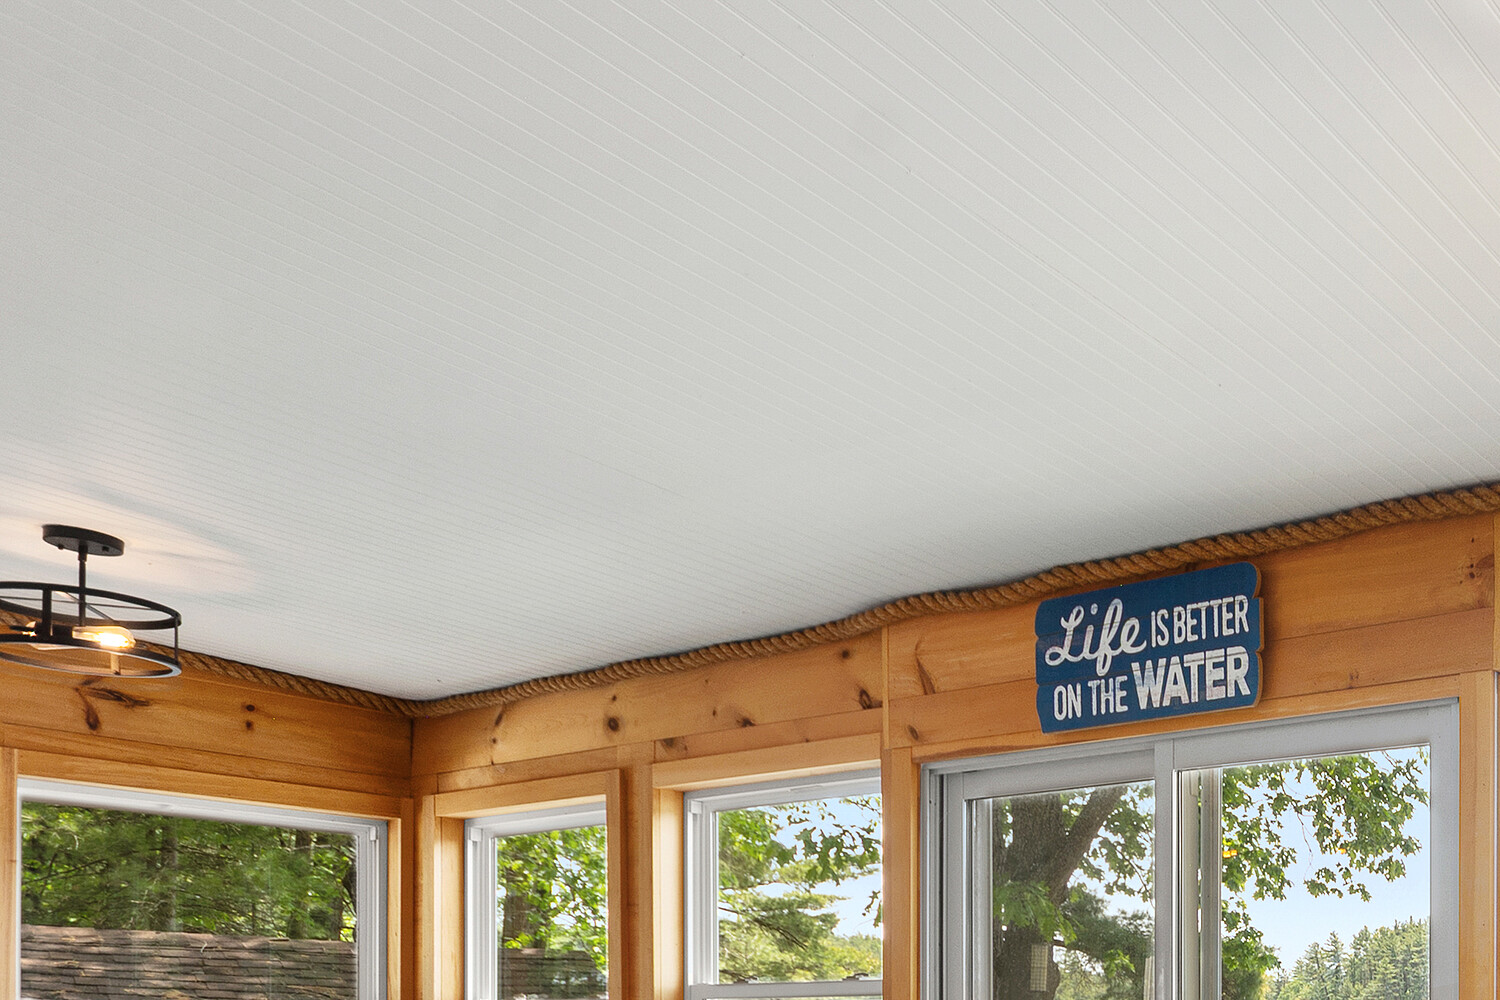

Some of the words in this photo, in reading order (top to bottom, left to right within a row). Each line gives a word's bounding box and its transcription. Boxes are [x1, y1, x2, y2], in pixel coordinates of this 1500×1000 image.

[1045, 598, 1147, 676] Life
[1151, 608, 1169, 648] IS
[1173, 594, 1249, 645] BETTER
[1053, 683, 1082, 721] ON
[1087, 675, 1129, 716] THE
[1131, 646, 1251, 710] WATER
